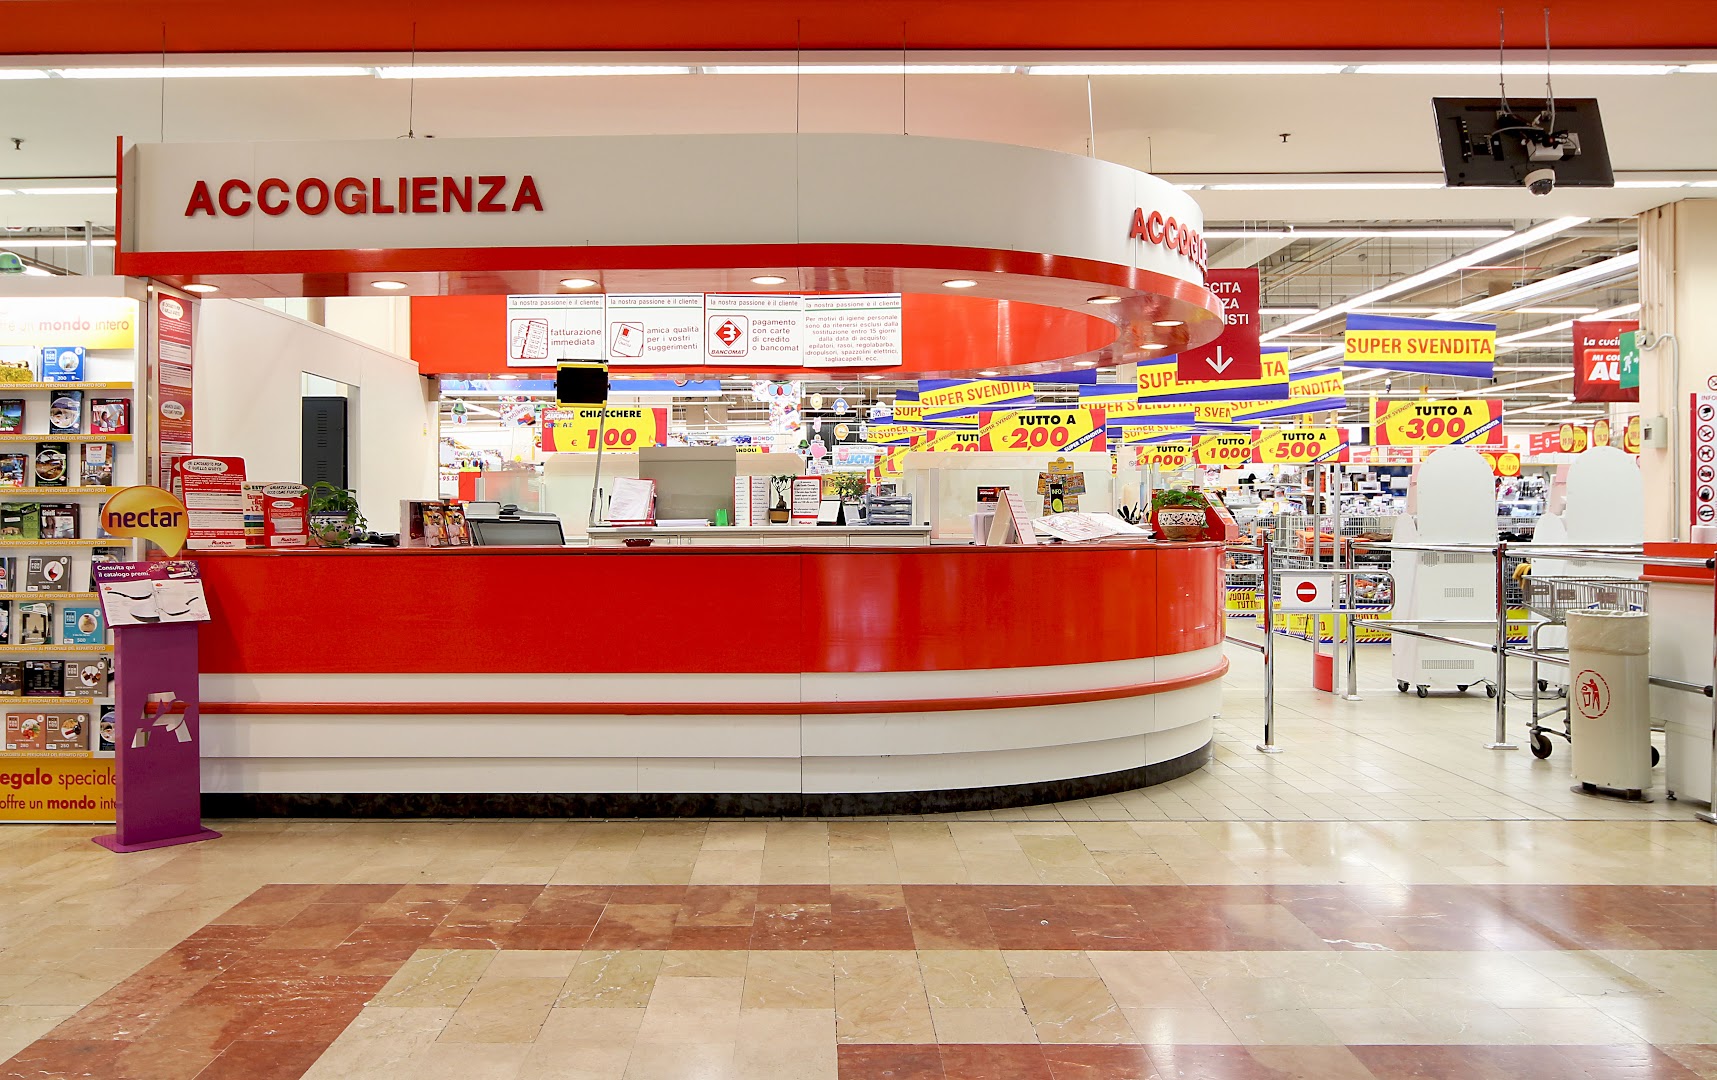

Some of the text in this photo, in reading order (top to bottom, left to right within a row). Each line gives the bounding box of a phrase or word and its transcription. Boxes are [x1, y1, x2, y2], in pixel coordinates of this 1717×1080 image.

[184, 174, 544, 217] ACCOGLIENZA
[40, 316, 129, 330] mondo intero
[673, 326, 699, 335] qualità
[647, 343, 698, 352] suggerimenti
[1346, 338, 1492, 354] SUPER SVENDITA
[1584, 337, 1595, 346] La
[922, 382, 1031, 410] SUPER SVENDITA
[996, 411, 1018, 426] SVENDITA
[1415, 406, 1472, 416] TUTTO A
[1019, 414, 1076, 425] TUTTO A
[1476, 419, 1500, 434] SVENDITA
[1080, 428, 1103, 444] SVENDITA
[1406, 417, 1465, 440] 3,00
[1008, 426, 1069, 451] 2,00
[1275, 442, 1320, 459] 5,00
[109, 508, 182, 527] nectar
[1229, 593, 1250, 601] VUOTA
[58, 767, 117, 790] speciale
[30, 799, 43, 809] un
[47, 795, 96, 810] mondo
